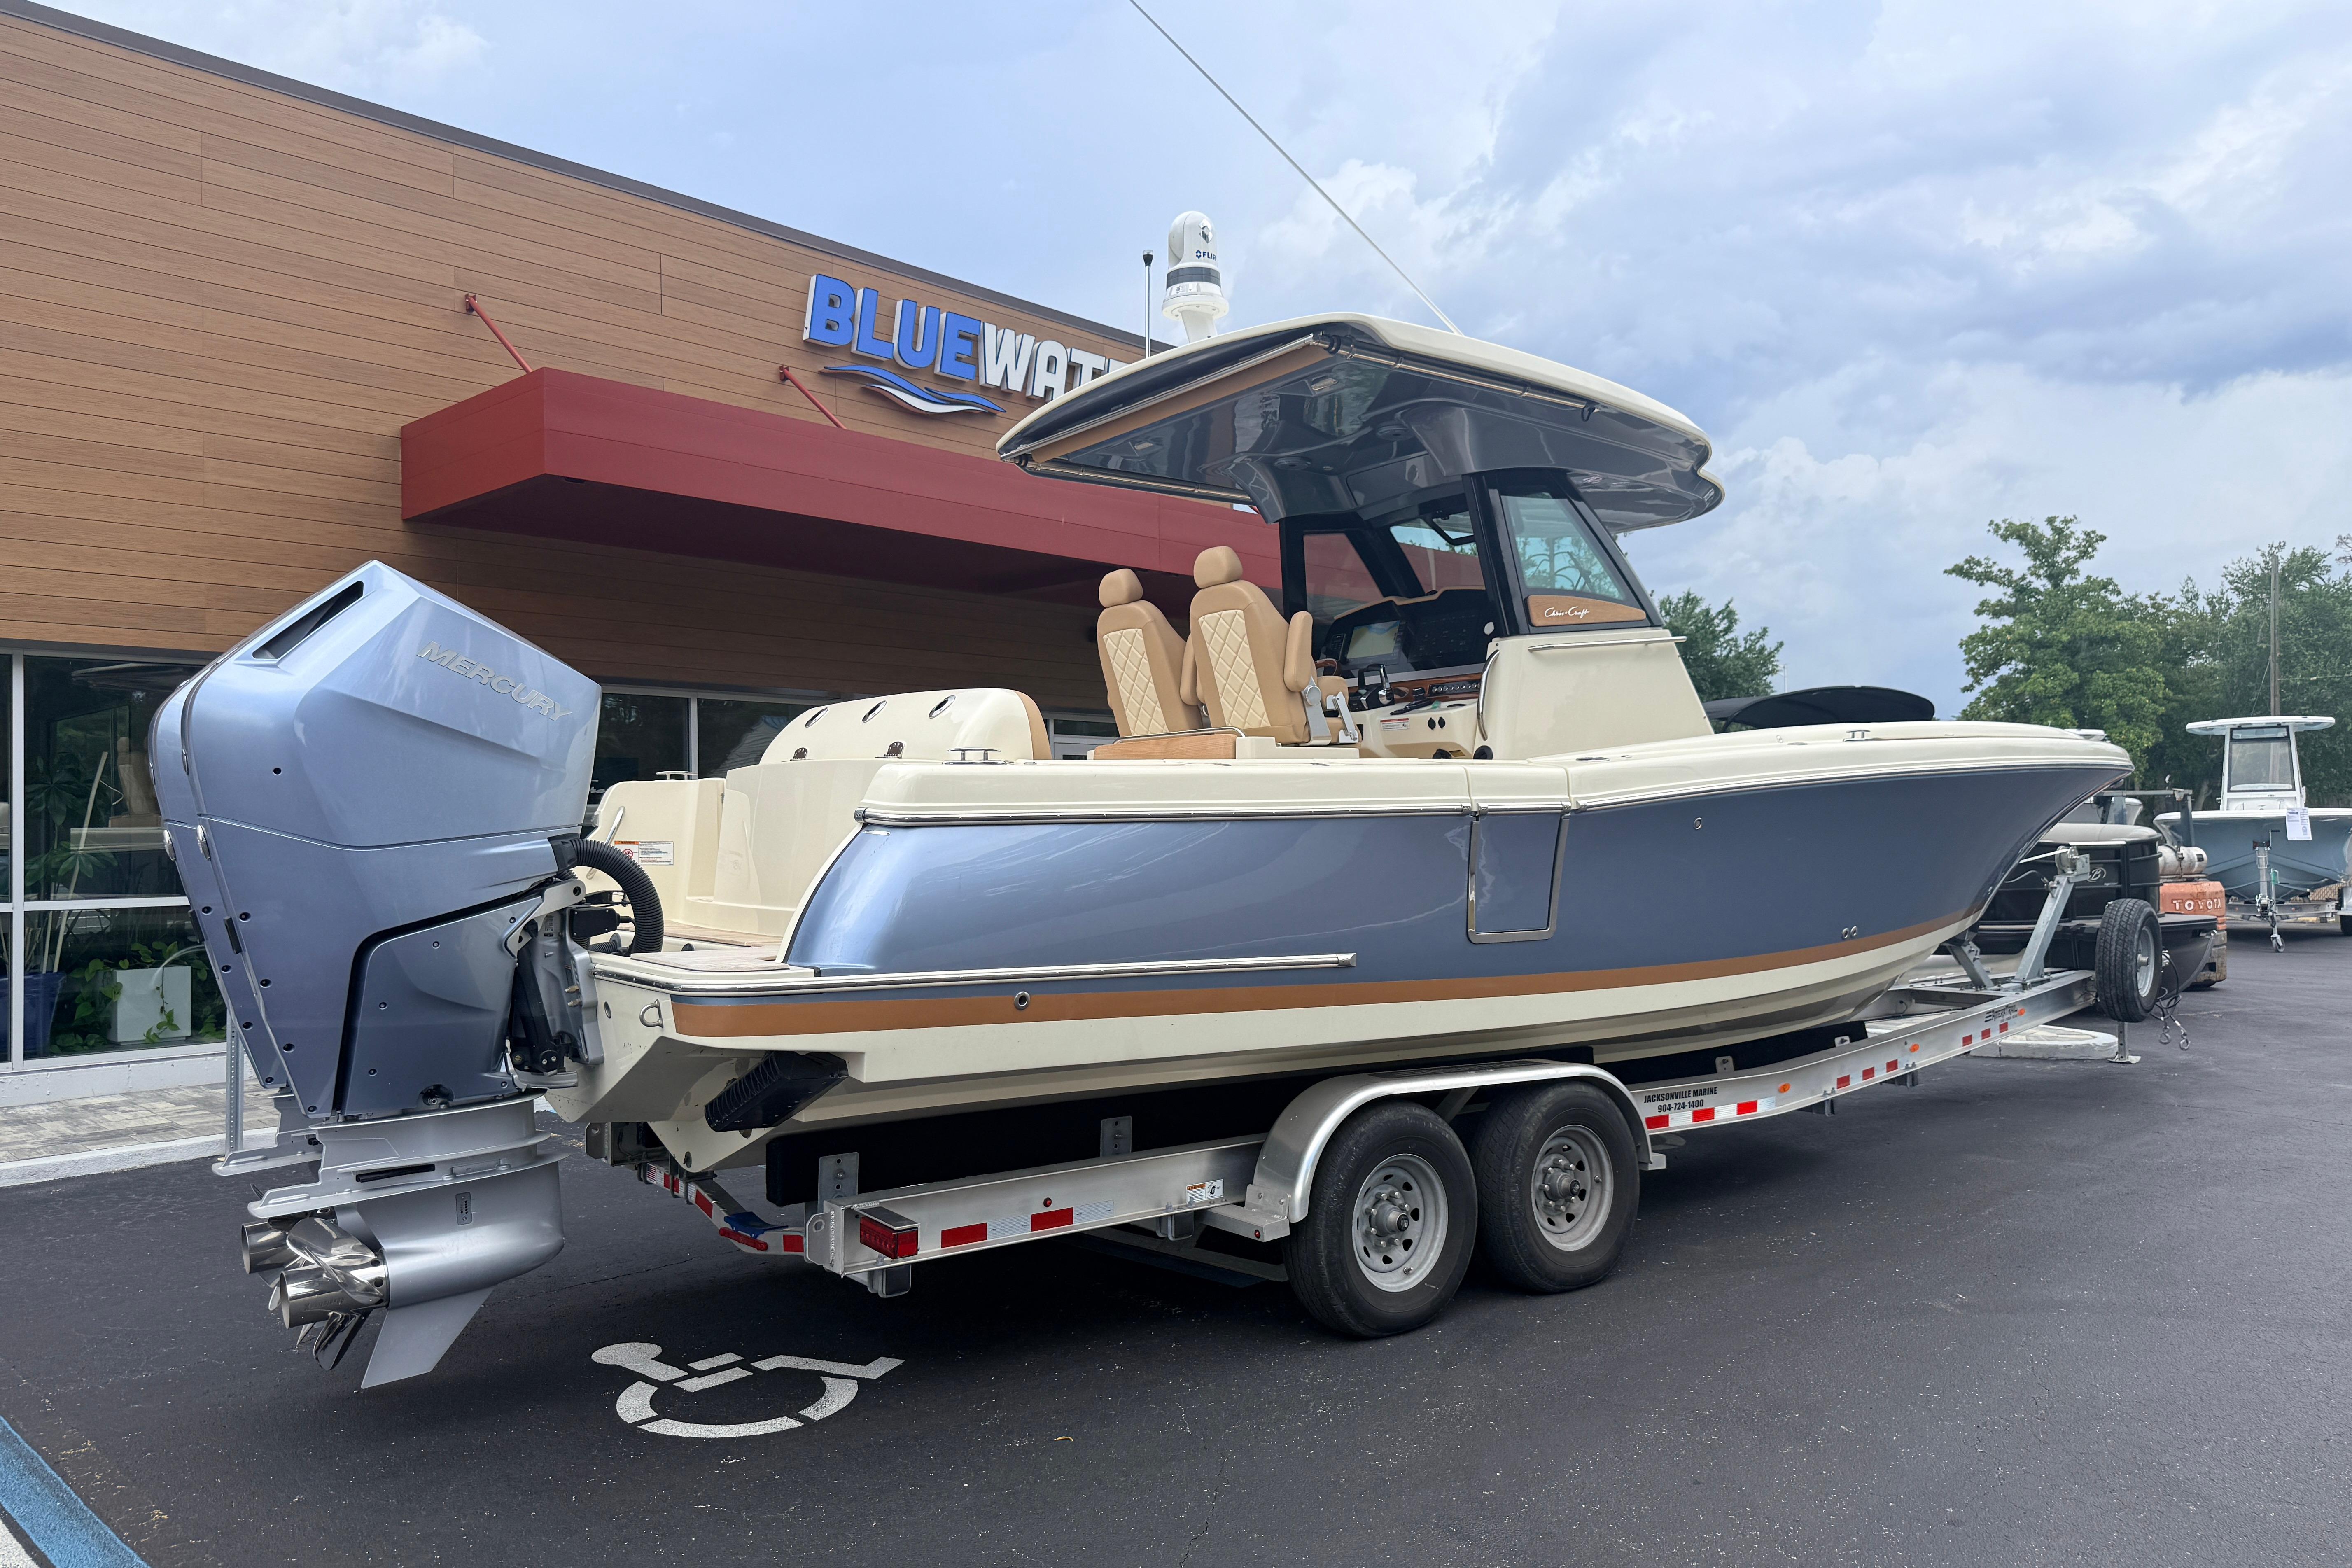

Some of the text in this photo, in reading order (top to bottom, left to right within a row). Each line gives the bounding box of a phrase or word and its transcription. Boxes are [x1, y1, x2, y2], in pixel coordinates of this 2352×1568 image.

[1202, 251, 1216, 261] FLIR
[416, 640, 572, 722] MERCURY
[2172, 898, 2222, 911] TOYOTA
[1644, 1087, 1717, 1103] JACKSONVILLE MARINE
[1658, 1099, 1704, 1113] 904-724-1400
